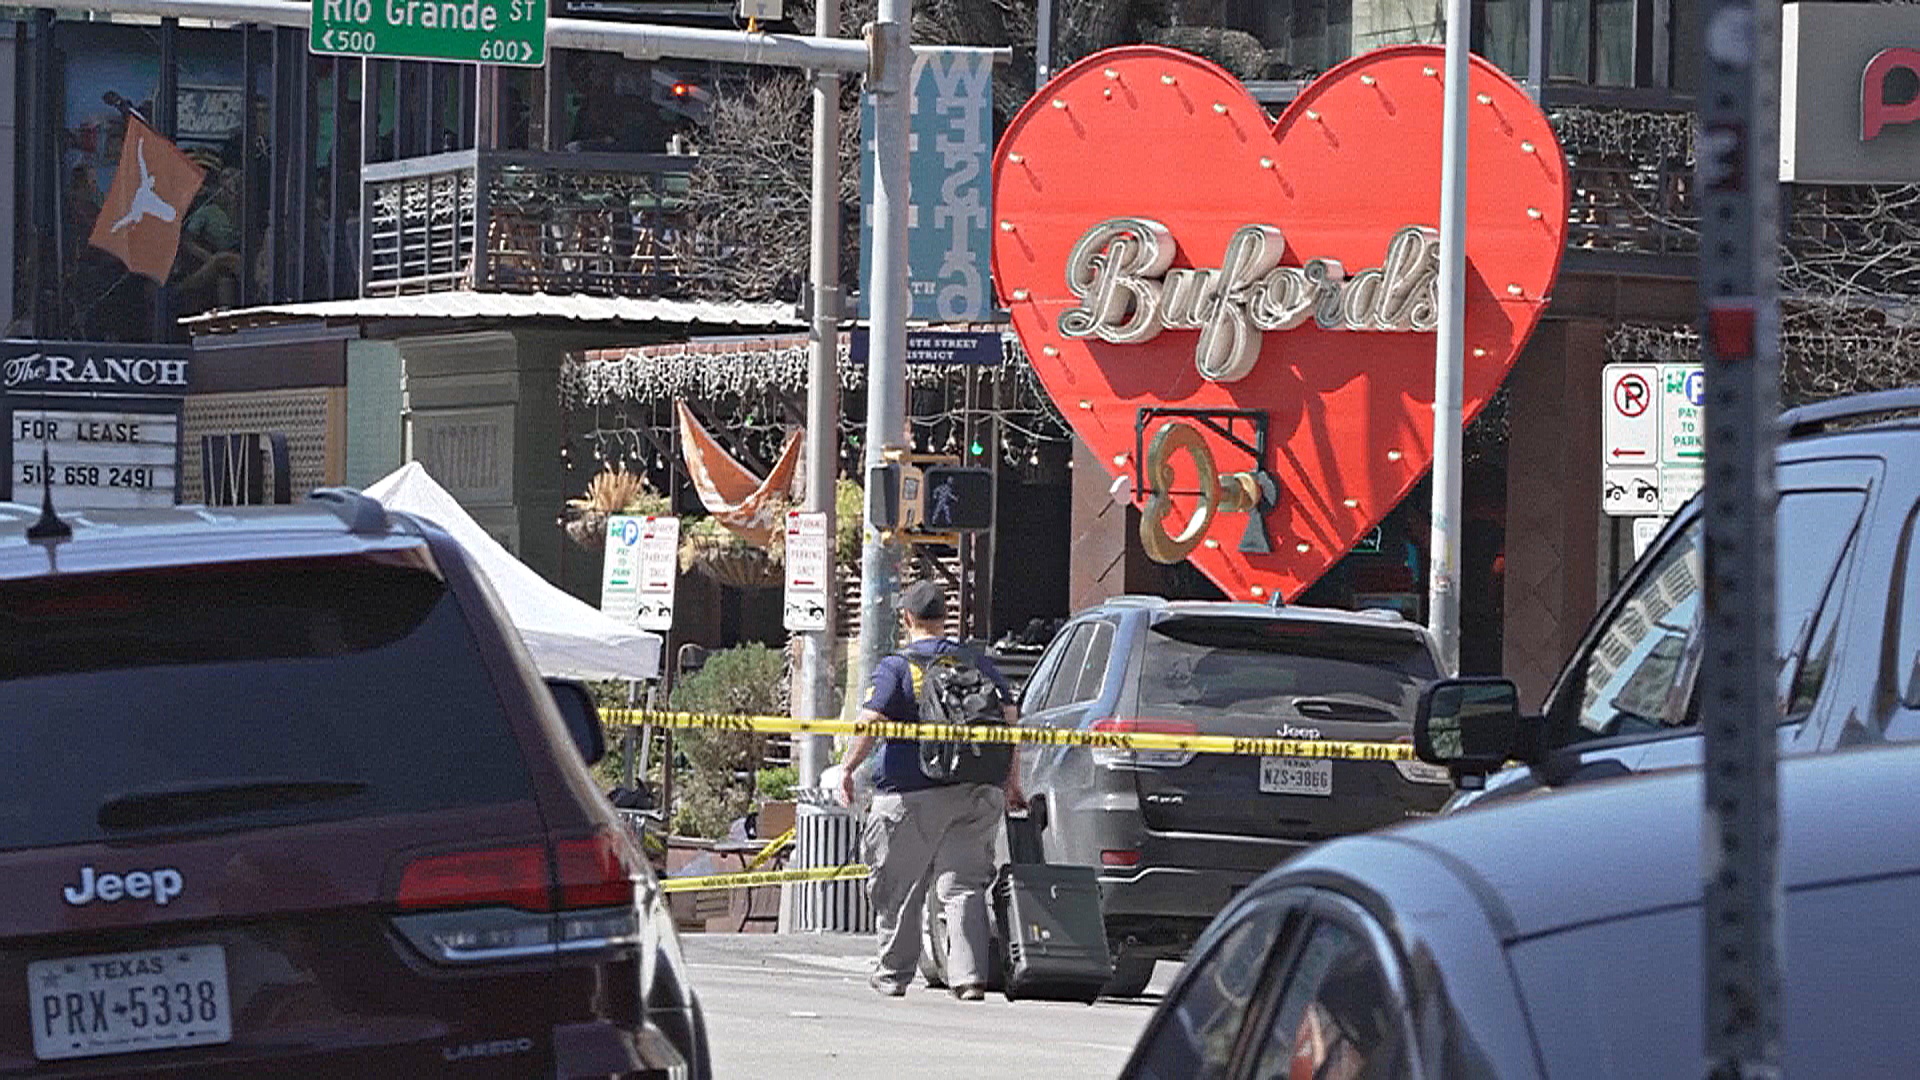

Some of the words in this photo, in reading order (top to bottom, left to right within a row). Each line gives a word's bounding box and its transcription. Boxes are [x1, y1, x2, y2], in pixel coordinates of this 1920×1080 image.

[322, 0, 372, 23] Rio
[385, 0, 497, 31] Grande
[509, 0, 536, 21] ST
[337, 31, 376, 51] 500
[479, 40, 518, 61] 600
[934, 338, 978, 349] STREET
[907, 351, 955, 361] ISTRICT
[4, 353, 46, 387] The
[46, 356, 189, 386] RANCH
[1678, 408, 1698, 418] PAY
[20, 420, 58, 441] FOR
[77, 423, 140, 443] LEASE
[1682, 422, 1695, 433] TO
[1673, 435, 1703, 447] PARK
[23, 465, 55, 485] 512
[64, 467, 100, 486] 658
[109, 468, 153, 487] 2491
[1276, 723, 1322, 740] Jeep
[1233, 740, 1304, 757] POLICE
[1312, 742, 1356, 758] LINE
[64, 866, 183, 906] Jeep
[90, 957, 164, 980] TEXAS
